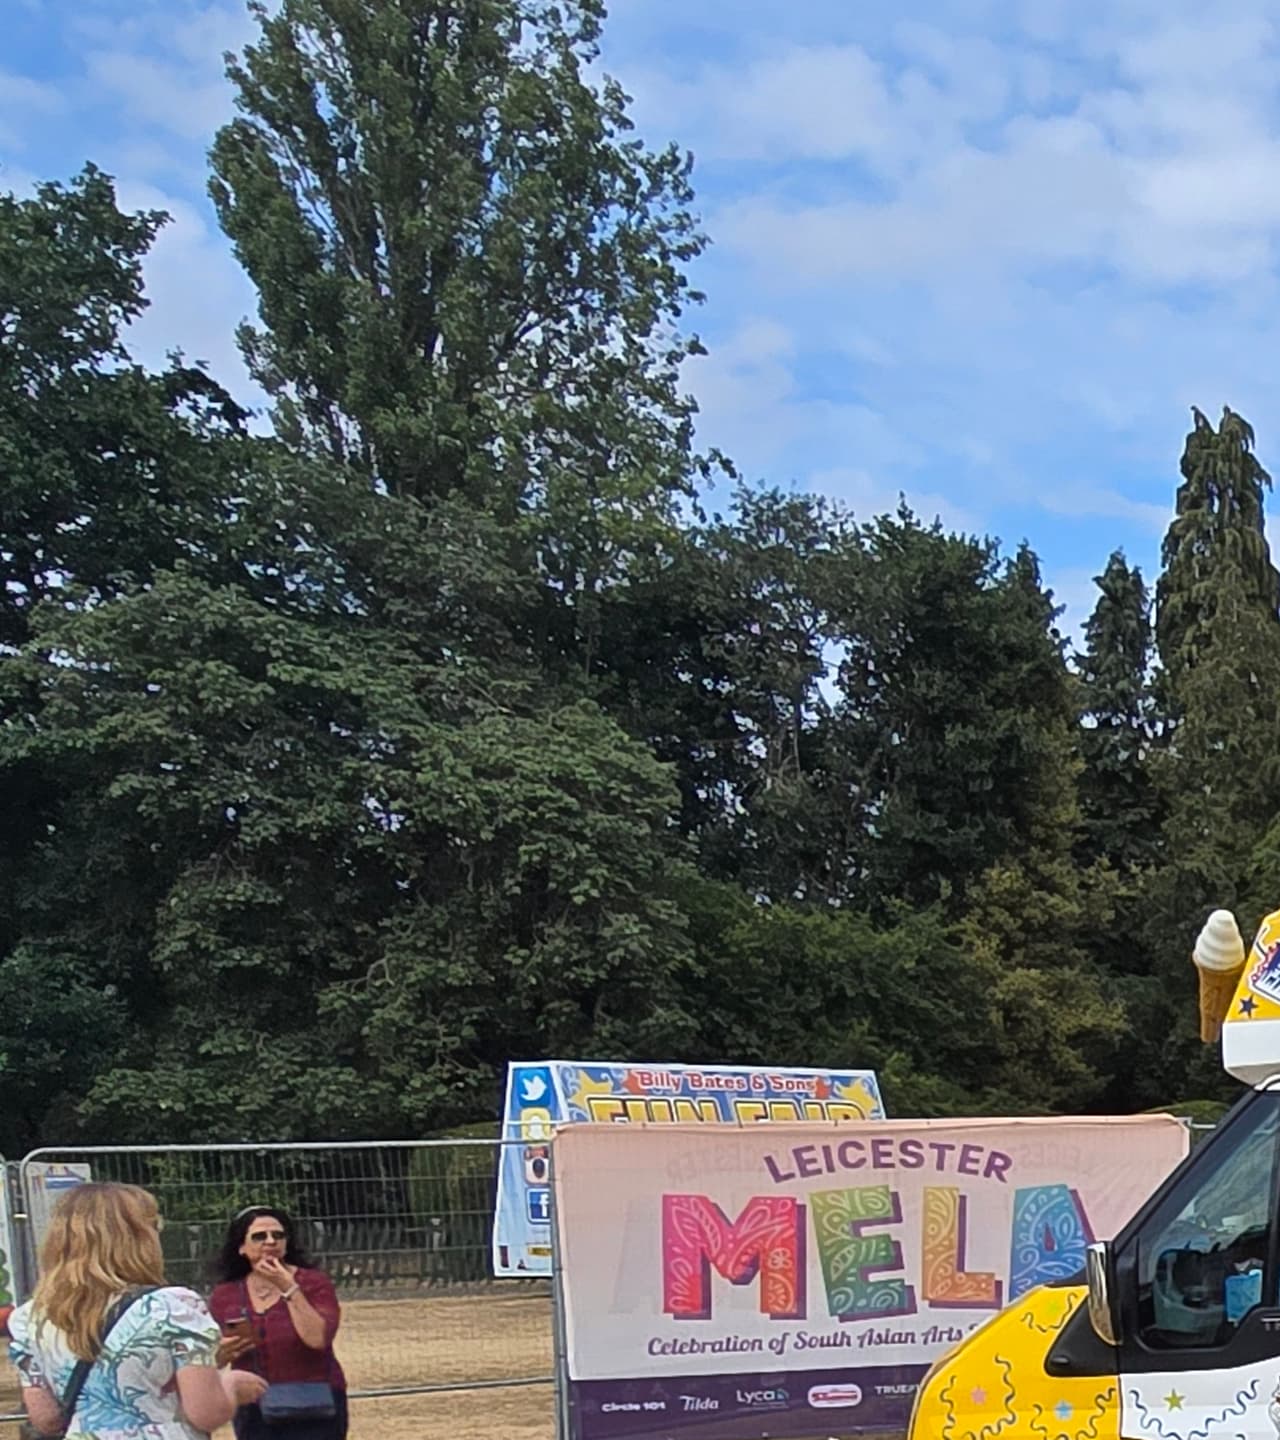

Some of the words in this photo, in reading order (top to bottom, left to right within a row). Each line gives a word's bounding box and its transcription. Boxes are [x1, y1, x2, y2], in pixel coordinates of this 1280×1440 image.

[635, 1070, 683, 1092] Billy
[684, 1072, 745, 1091] Bates
[751, 1074, 763, 1091] &
[767, 1074, 816, 1092] Sons
[764, 1138, 1013, 1184] LEICESTER
[662, 1183, 1095, 1321] MELA
[648, 1335, 763, 1357] Celebration
[768, 1332, 790, 1356] of
[794, 1330, 852, 1351] South
[857, 1327, 916, 1349] Asian
[921, 1325, 964, 1346] Arts
[679, 1395, 720, 1412] Tilda
[736, 1389, 776, 1405] Lyca
